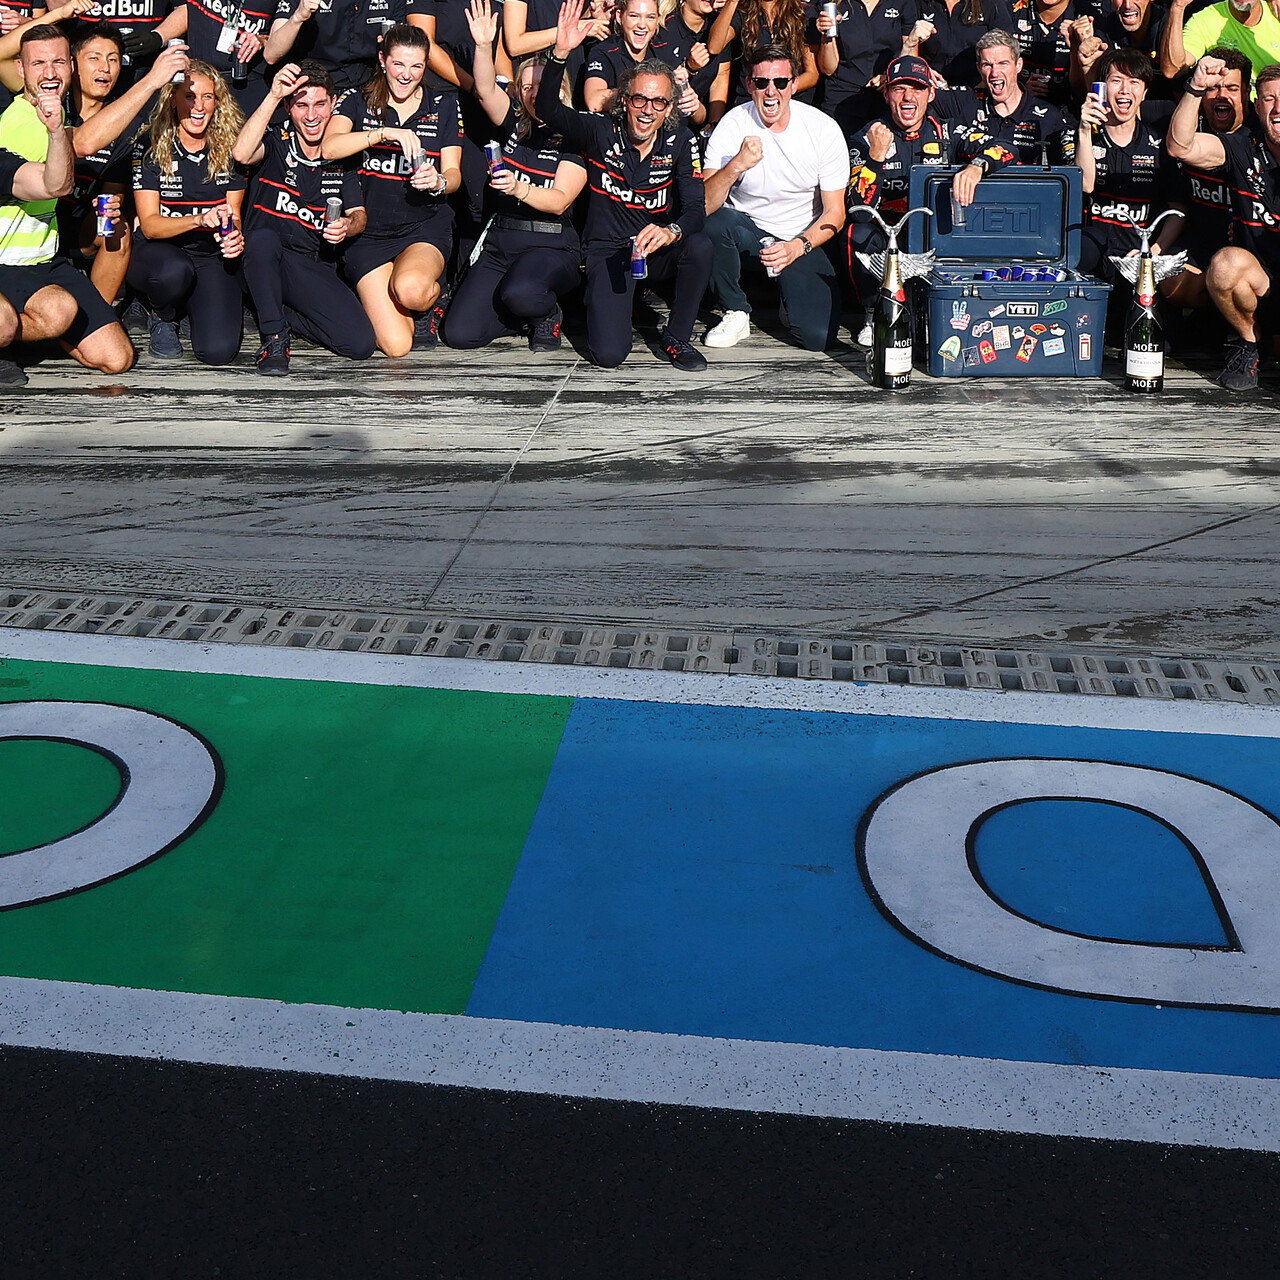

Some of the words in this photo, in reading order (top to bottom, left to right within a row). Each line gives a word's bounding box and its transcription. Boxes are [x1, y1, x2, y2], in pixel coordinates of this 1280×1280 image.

[362, 150, 396, 172] Red
[1191, 178, 1223, 203] Red
[964, 206, 1040, 234] YETI
[1252, 201, 1276, 226] Re
[1008, 305, 1036, 315] YETI
